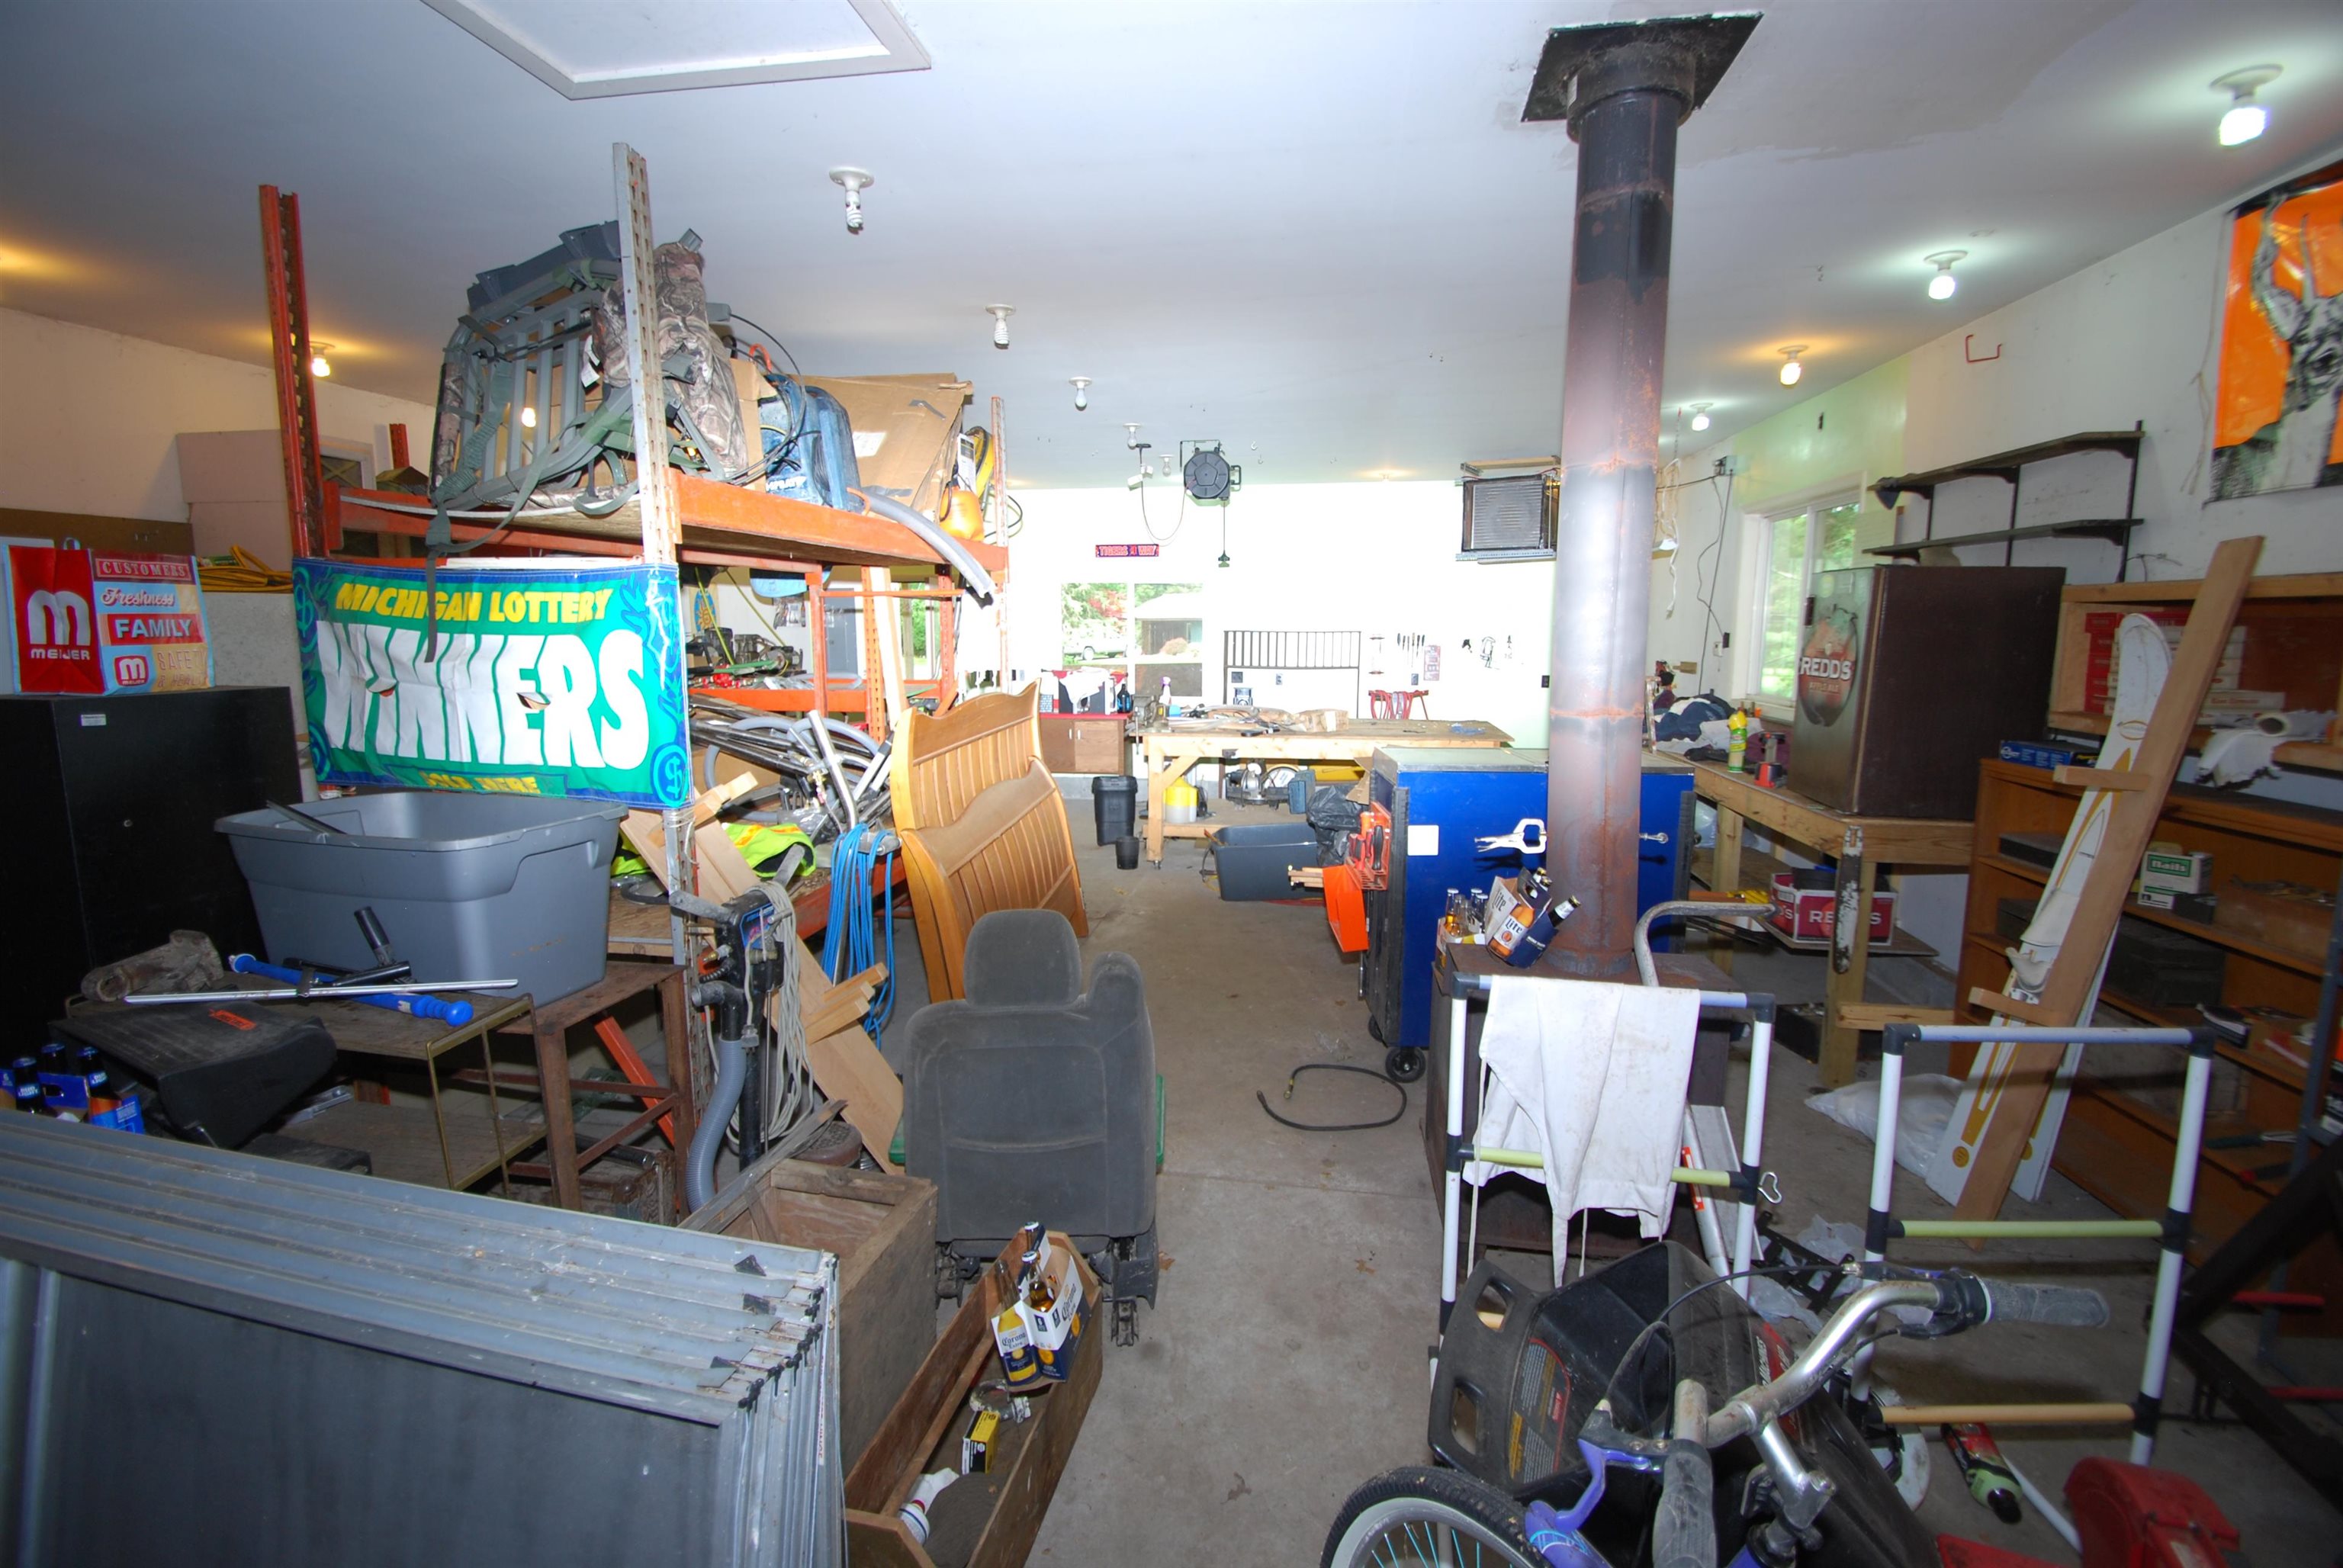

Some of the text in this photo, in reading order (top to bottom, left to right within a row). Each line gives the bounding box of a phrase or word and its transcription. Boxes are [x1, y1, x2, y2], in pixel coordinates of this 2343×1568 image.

[102, 561, 185, 577] CUSTOMERS
[101, 586, 175, 606] Freshness
[335, 582, 613, 624] MICHIGAN LOTTERY
[115, 619, 192, 639] FAMILY
[31, 648, 91, 660] MEIJER
[157, 648, 207, 670] SAFETY
[317, 620, 650, 770] WINNERS
[474, 776, 542, 794] HERE
[1505, 917, 1523, 933] Lite
[1001, 1332, 1027, 1347] Corona
